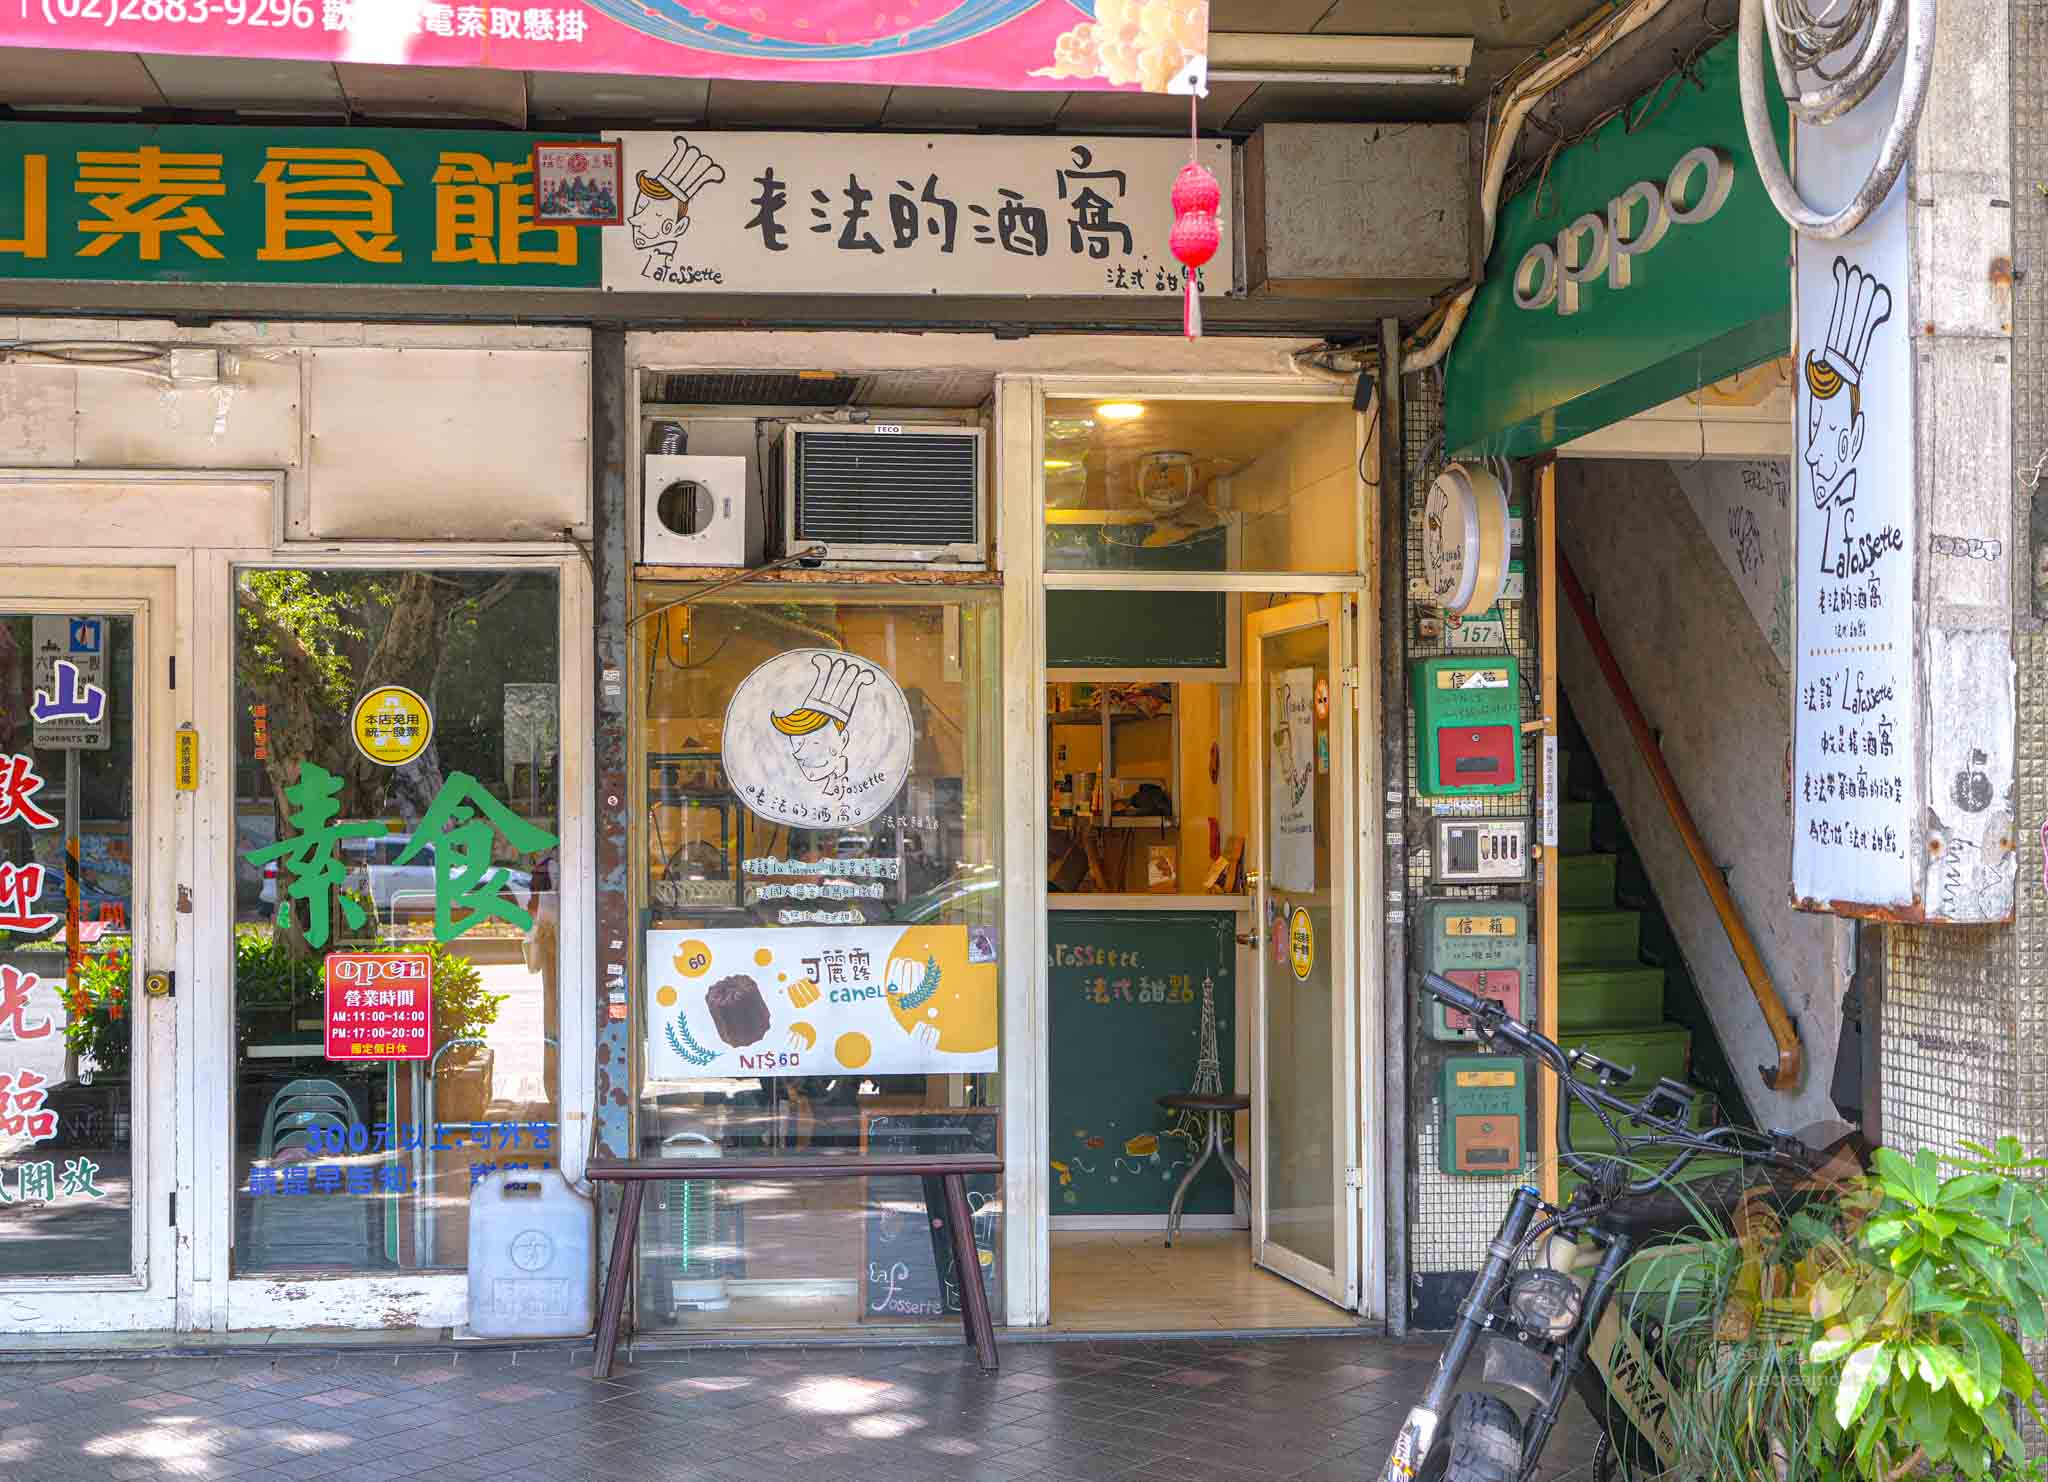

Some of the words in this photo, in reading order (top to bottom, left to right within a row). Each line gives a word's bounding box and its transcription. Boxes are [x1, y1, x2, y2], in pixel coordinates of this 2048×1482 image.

[322, 0, 589, 42] 歡電索取懸掛
[744, 145, 1133, 259] 老法的酒窩
[365, 714, 419, 725] 本店免用
[245, 760, 560, 950] 素食
[335, 961, 425, 986] open
[688, 953, 707, 970] 60
[801, 947, 872, 985] 可麗露
[344, 989, 415, 1008] 營業時間
[0, 1156, 106, 1203] 開放
